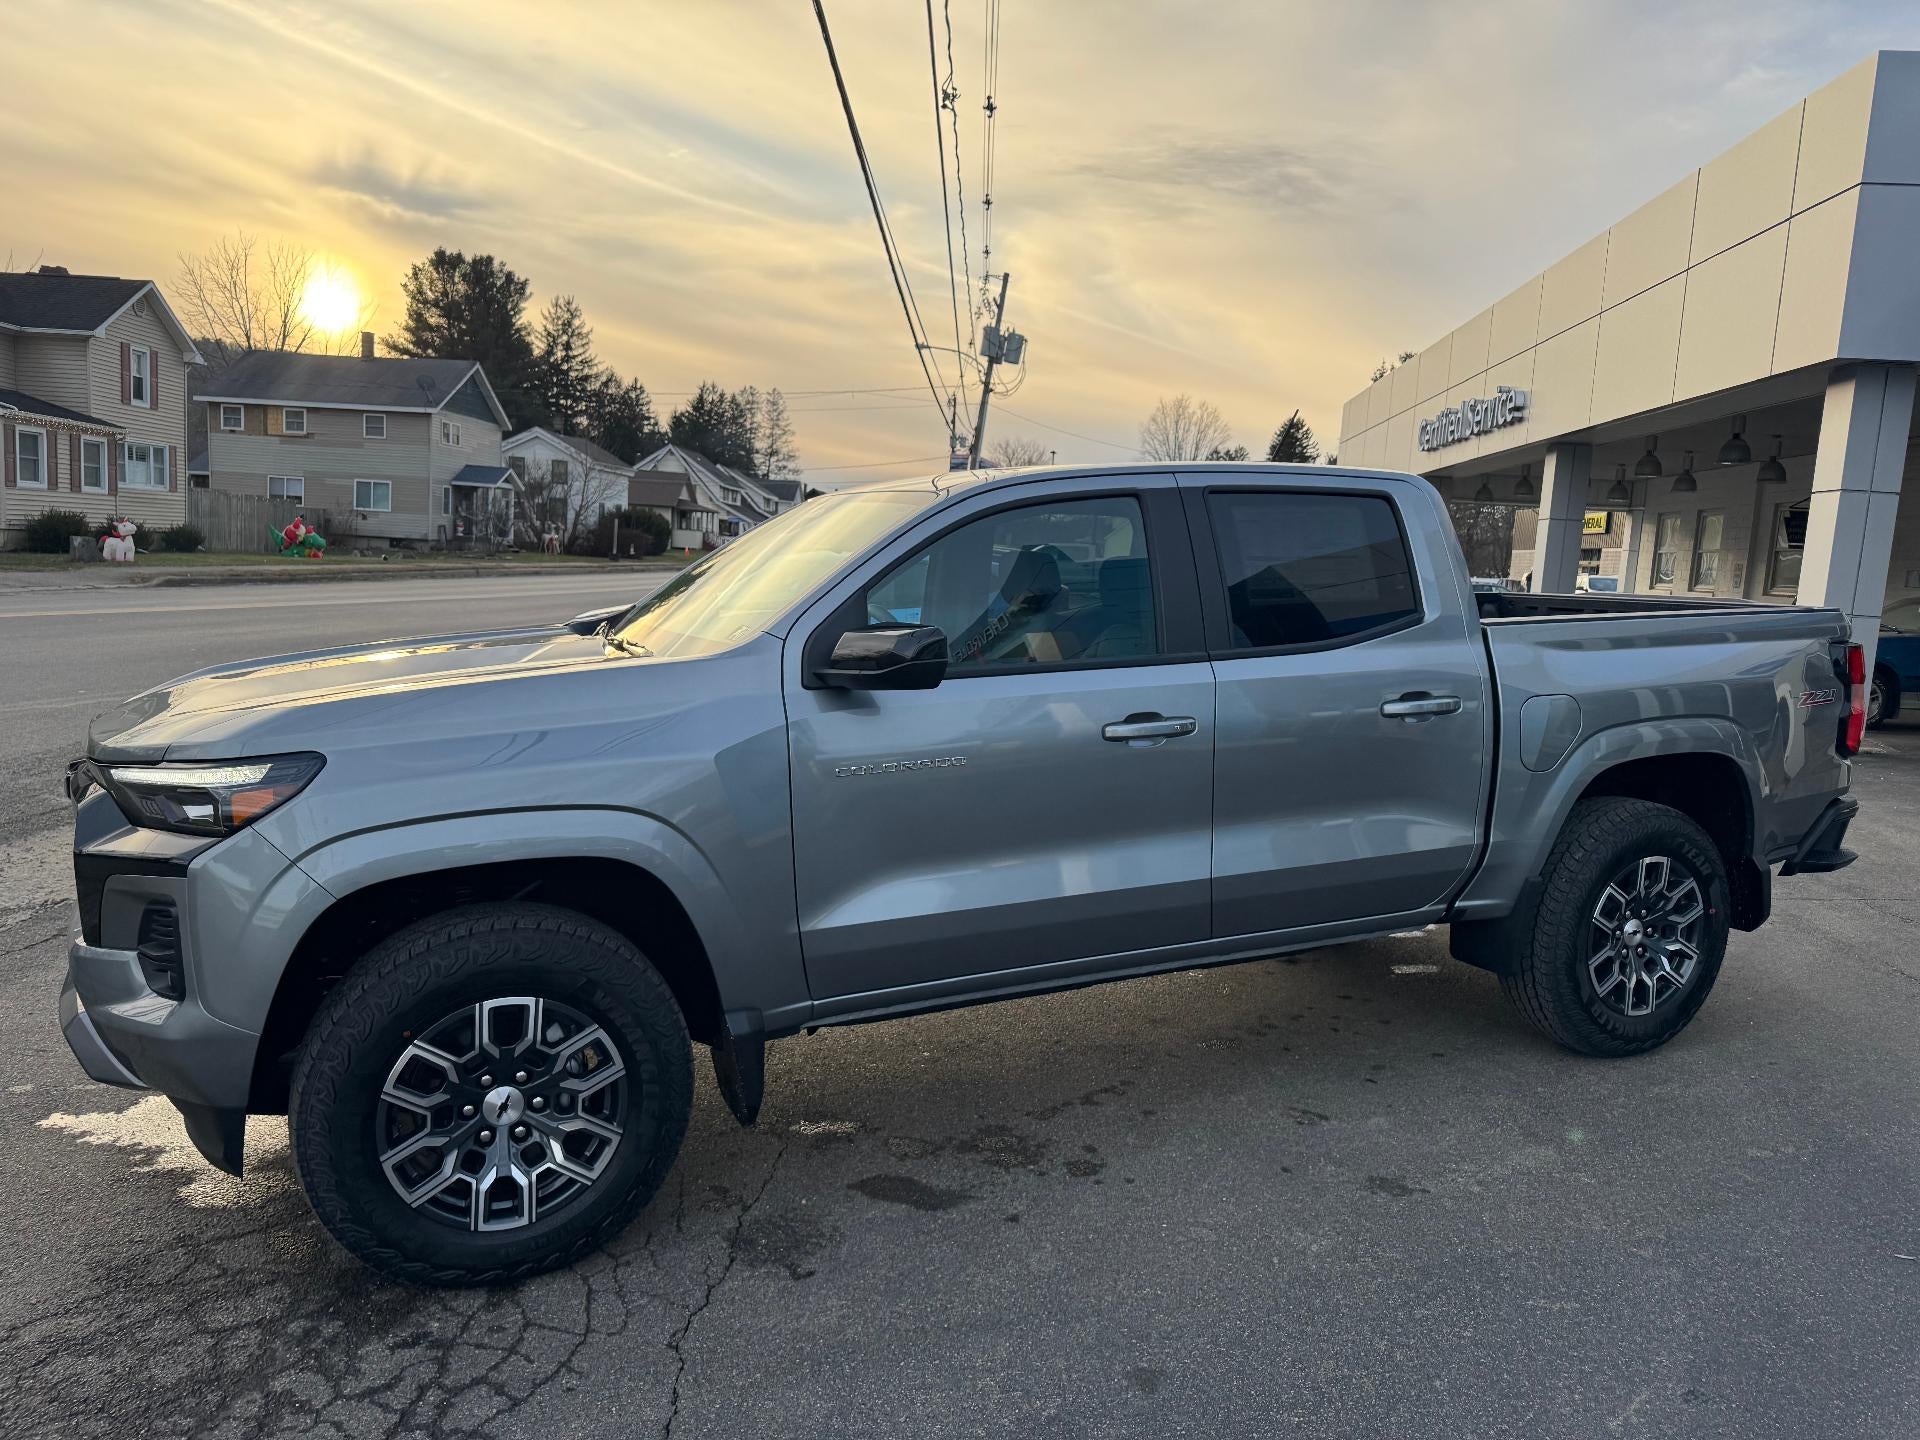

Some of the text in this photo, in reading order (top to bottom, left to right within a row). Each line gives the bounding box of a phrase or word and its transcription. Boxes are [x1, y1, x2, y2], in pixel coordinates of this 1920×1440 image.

[1418, 387, 1521, 451] Certified Service
[835, 756, 967, 777] COLORADO
